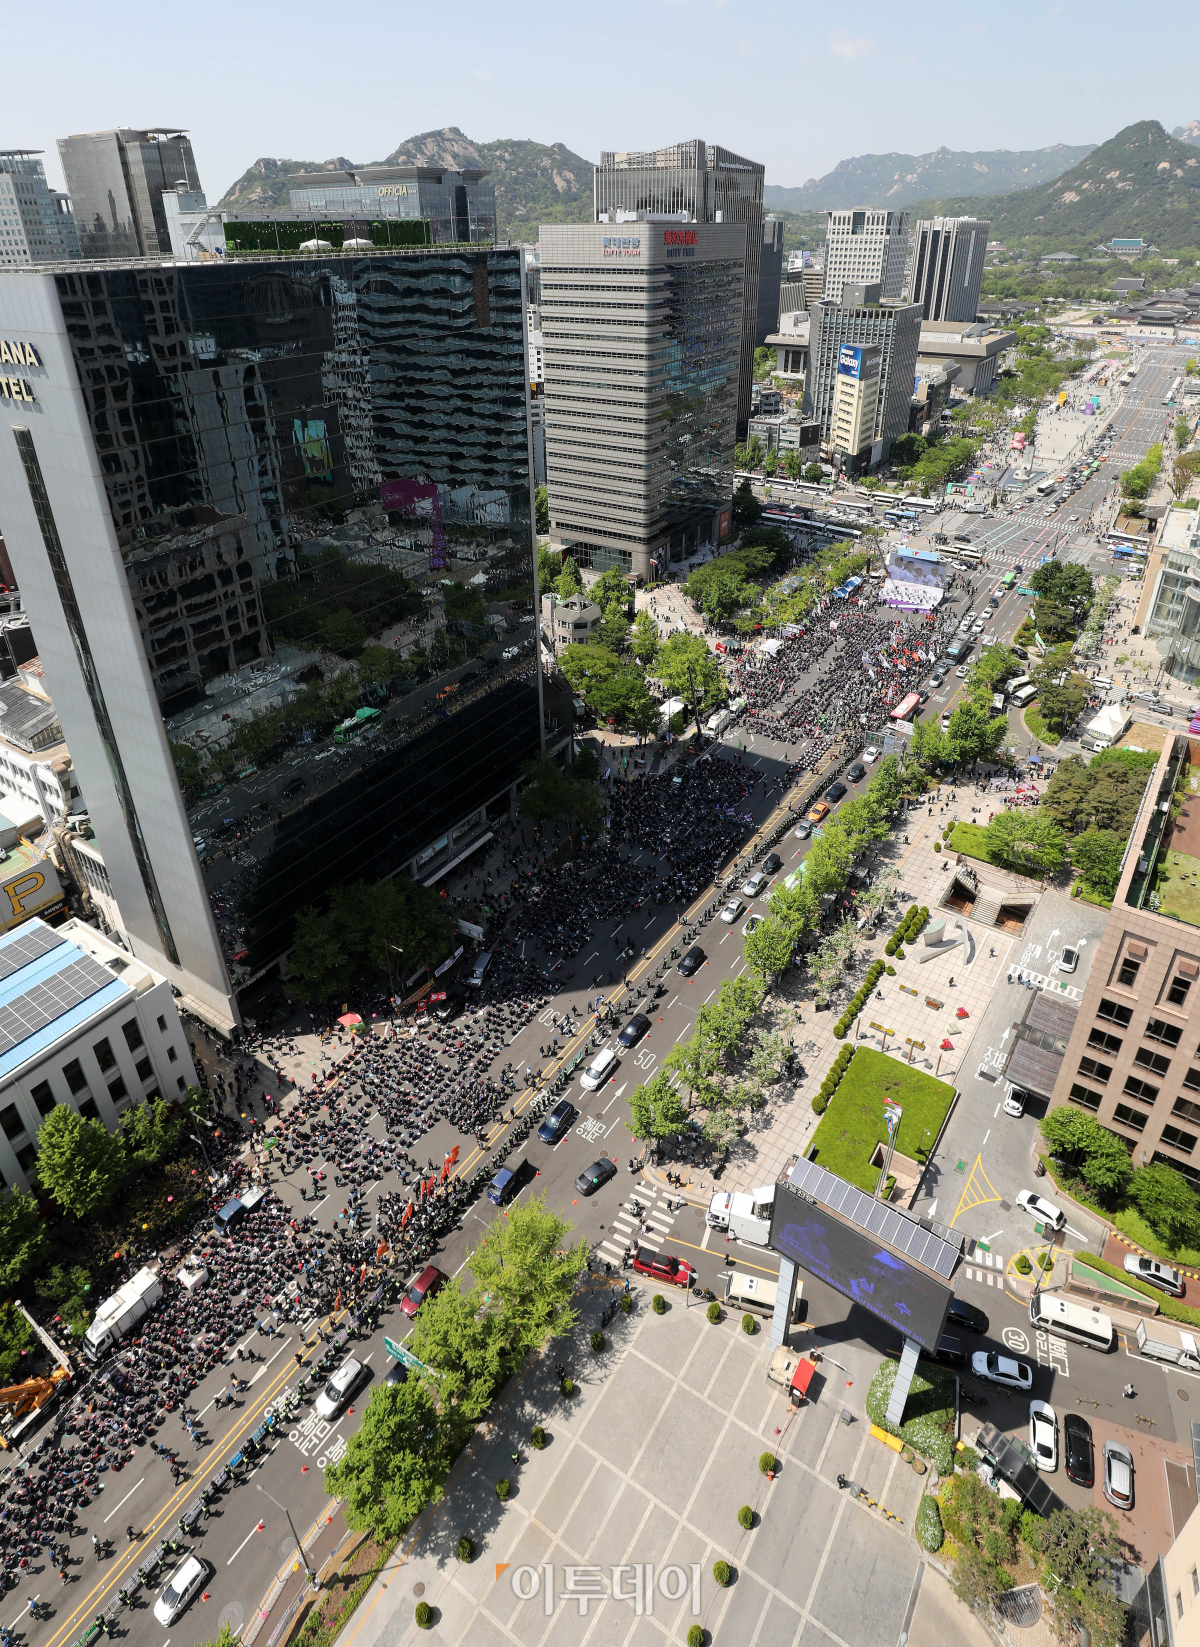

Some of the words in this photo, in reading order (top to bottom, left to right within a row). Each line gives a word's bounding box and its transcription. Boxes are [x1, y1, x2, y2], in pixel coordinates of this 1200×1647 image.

[378, 185, 408, 196] OFFICIA
[666, 248, 682, 258] DUTY
[683, 247, 696, 257] FREE
[0, 340, 41, 367] ANA
[3, 872, 45, 916] P
[633, 1049, 656, 1070] 50
[576, 1115, 606, 1144] 광화문
[1008, 1331, 1025, 1350] 30
[289, 1408, 331, 1457] 광화문
